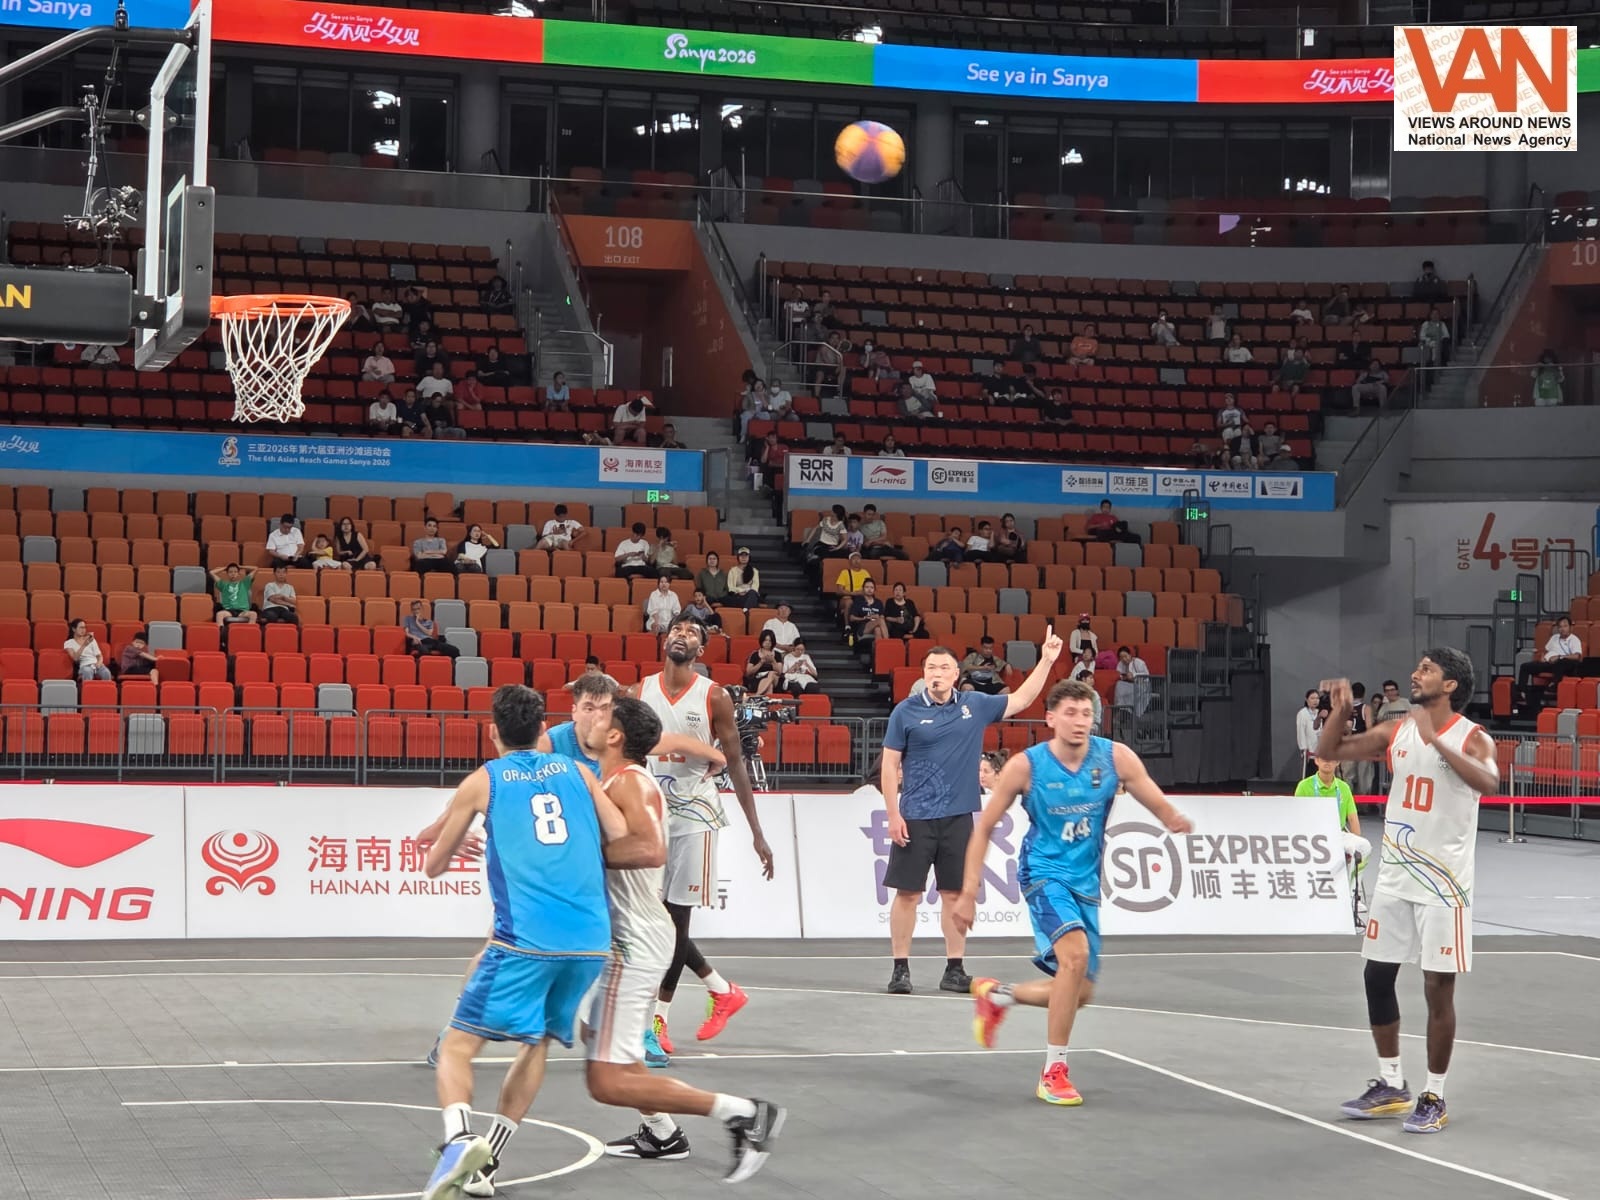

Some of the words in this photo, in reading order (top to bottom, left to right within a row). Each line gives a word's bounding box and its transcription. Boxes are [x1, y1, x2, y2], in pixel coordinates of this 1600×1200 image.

[967, 62, 999, 81] See
[1004, 70, 1025, 87] ya
[1030, 67, 1046, 84] in
[1052, 68, 1108, 91] Sanya
[605, 225, 643, 248] 108
[622, 256, 640, 264] EXIT
[278, 455, 298, 464] Asian
[323, 457, 348, 465] Games
[372, 458, 391, 467] 2026
[800, 470, 833, 482] NAN
[1457, 538, 1471, 571] GATE
[1402, 774, 1434, 813] 10
[531, 792, 569, 846] 8
[1061, 816, 1091, 843] 44
[1186, 834, 1331, 865] EXPRESS
[310, 879, 390, 896] HAINAN
[398, 880, 482, 896] AIRLINES
[1191, 868, 1337, 900] 顺丰速运
